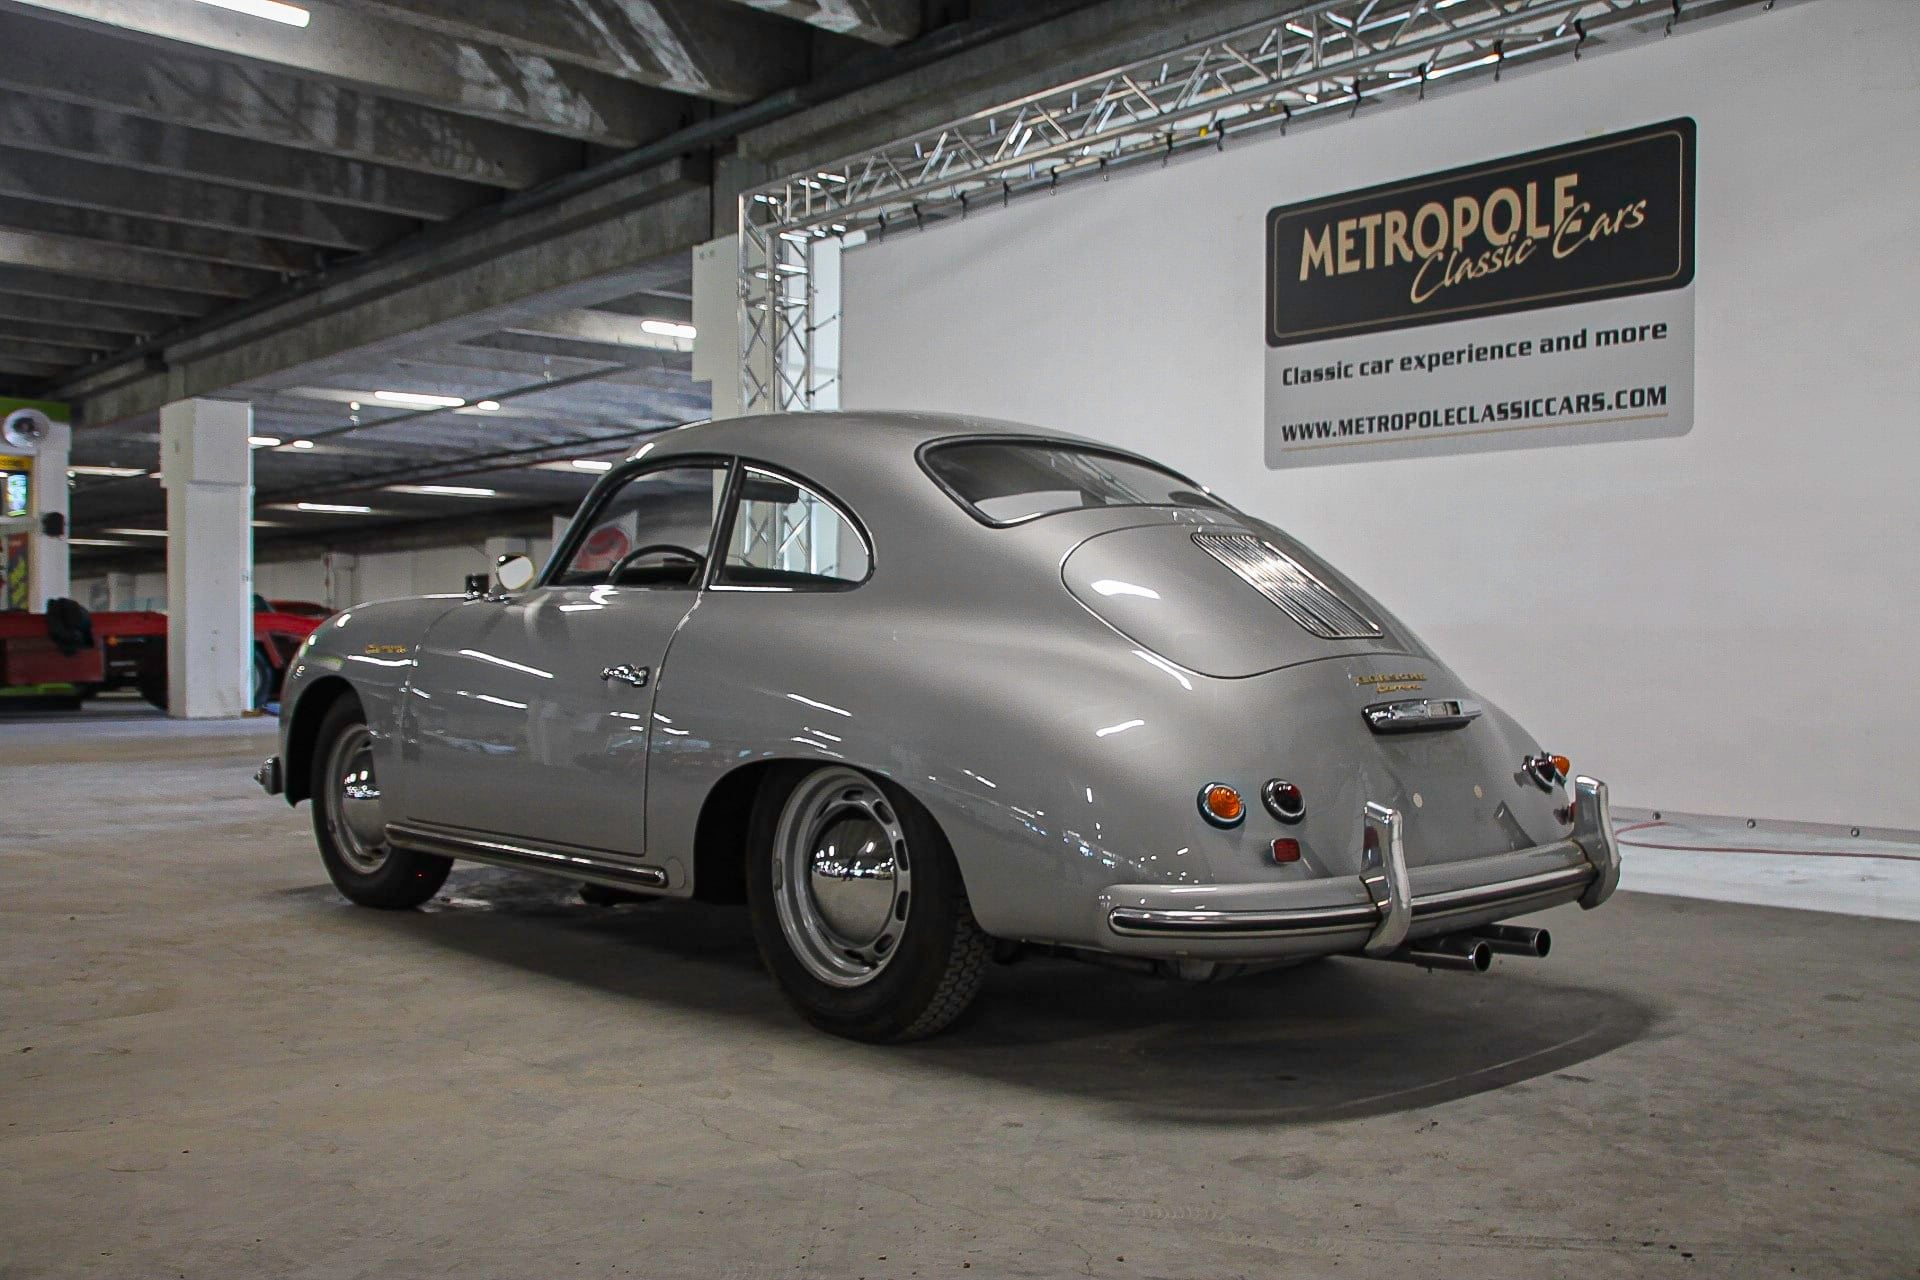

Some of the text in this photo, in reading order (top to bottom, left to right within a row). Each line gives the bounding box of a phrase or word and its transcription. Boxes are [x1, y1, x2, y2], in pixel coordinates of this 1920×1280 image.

[1299, 173, 1582, 281] METROPOLE
[1410, 198, 1647, 304] Classic Cars
[1282, 321, 1668, 386] Classic car experience and more
[1281, 385, 1668, 442] WWW.METROPOLECLASSICCARS.COM
